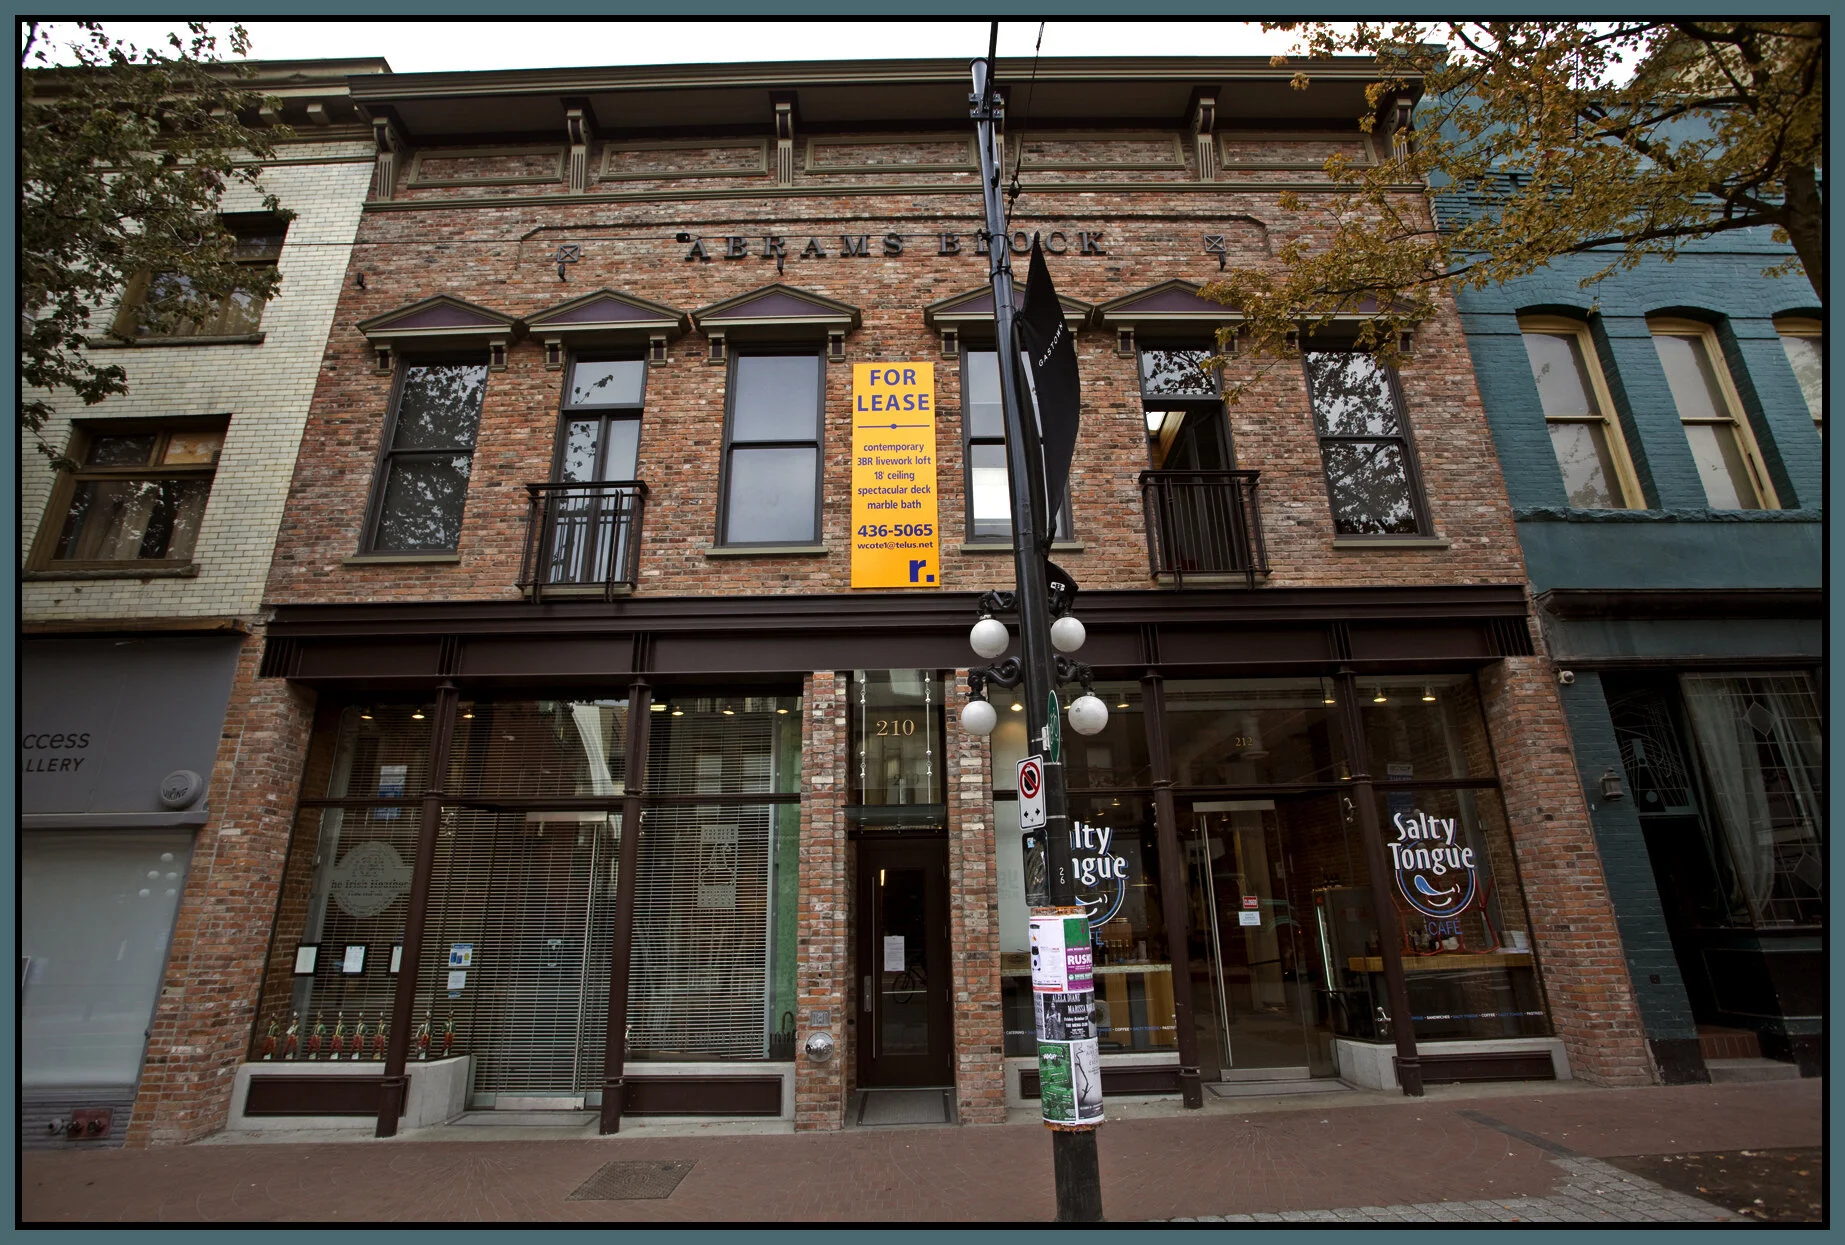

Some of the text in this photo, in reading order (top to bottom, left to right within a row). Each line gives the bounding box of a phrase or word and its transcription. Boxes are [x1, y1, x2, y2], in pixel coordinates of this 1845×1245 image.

[684, 232, 904, 261] ABRAMS
[1038, 321, 1063, 367] GASTOWN
[870, 369, 916, 386] FOR
[857, 394, 930, 412] LEASE
[863, 444, 924, 453] contemporary
[857, 455, 931, 466] 3BR livework loft
[887, 470, 915, 481] ceiling
[857, 484, 931, 497] spectacular deck
[867, 499, 922, 510] marble bath
[857, 524, 933, 538] 436-5065
[857, 541, 934, 550] wcote1@telus.net
[876, 719, 915, 736] 210
[22, 733, 91, 750] ccess
[1235, 736, 1253, 747] 212
[1393, 812, 1457, 846] Salty
[1069, 821, 1112, 856] lty
[1387, 842, 1476, 876] Tongue
[1072, 857, 1128, 886] ngue
[1428, 917, 1463, 937] CAFÉ
